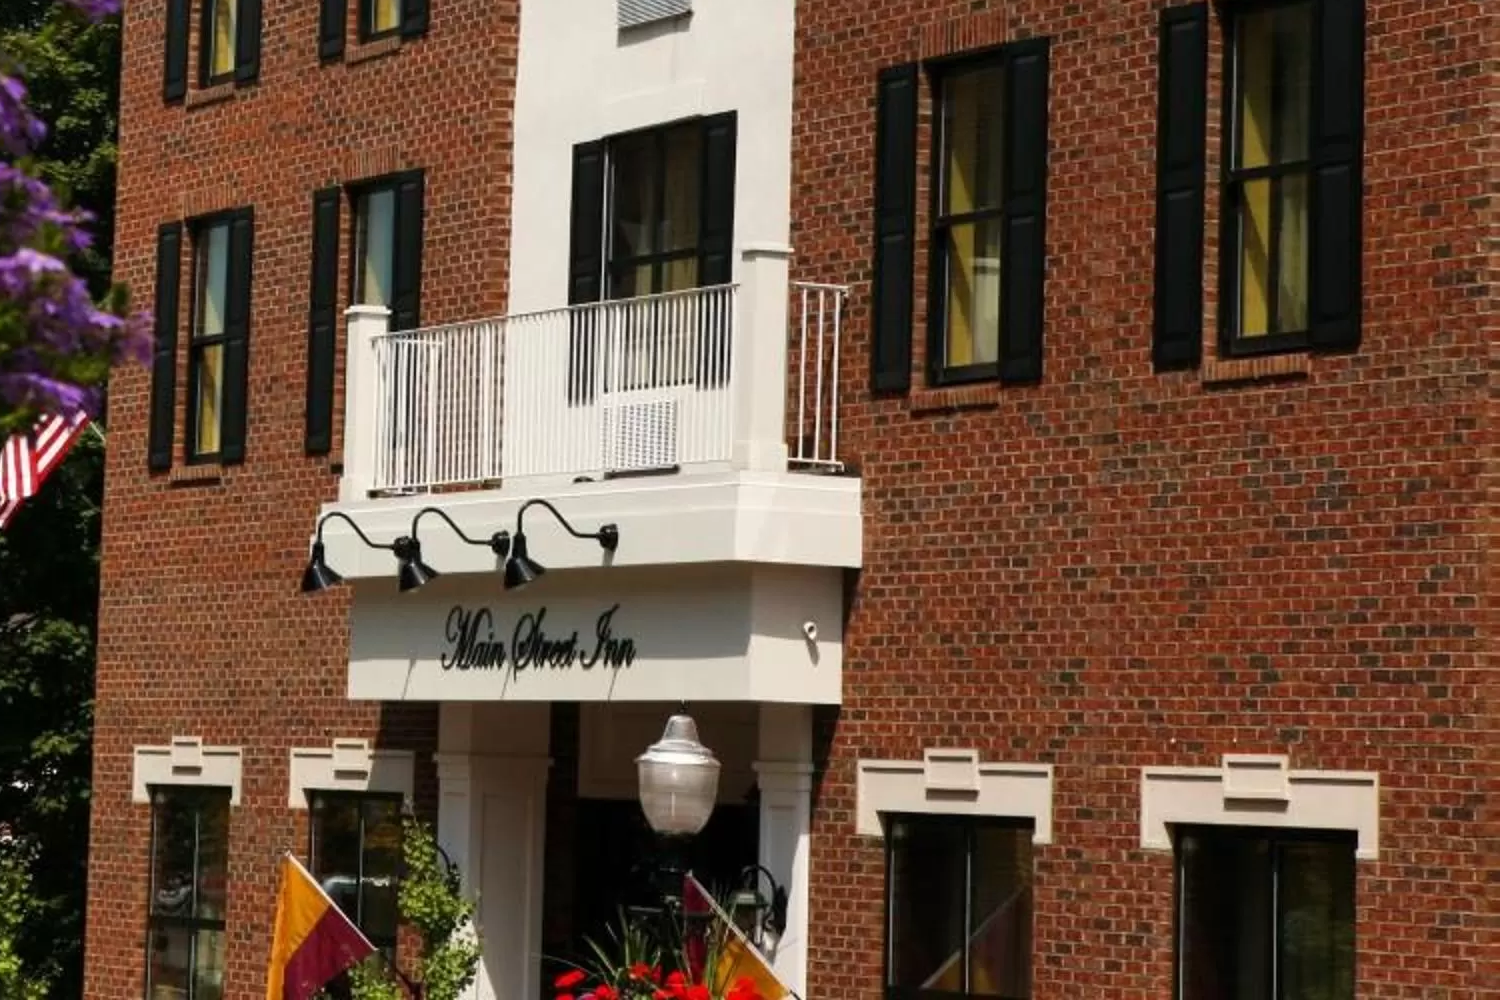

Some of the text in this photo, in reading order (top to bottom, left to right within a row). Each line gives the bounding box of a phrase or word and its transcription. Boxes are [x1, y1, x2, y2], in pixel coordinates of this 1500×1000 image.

[441, 603, 636, 682] Main Street Inn
